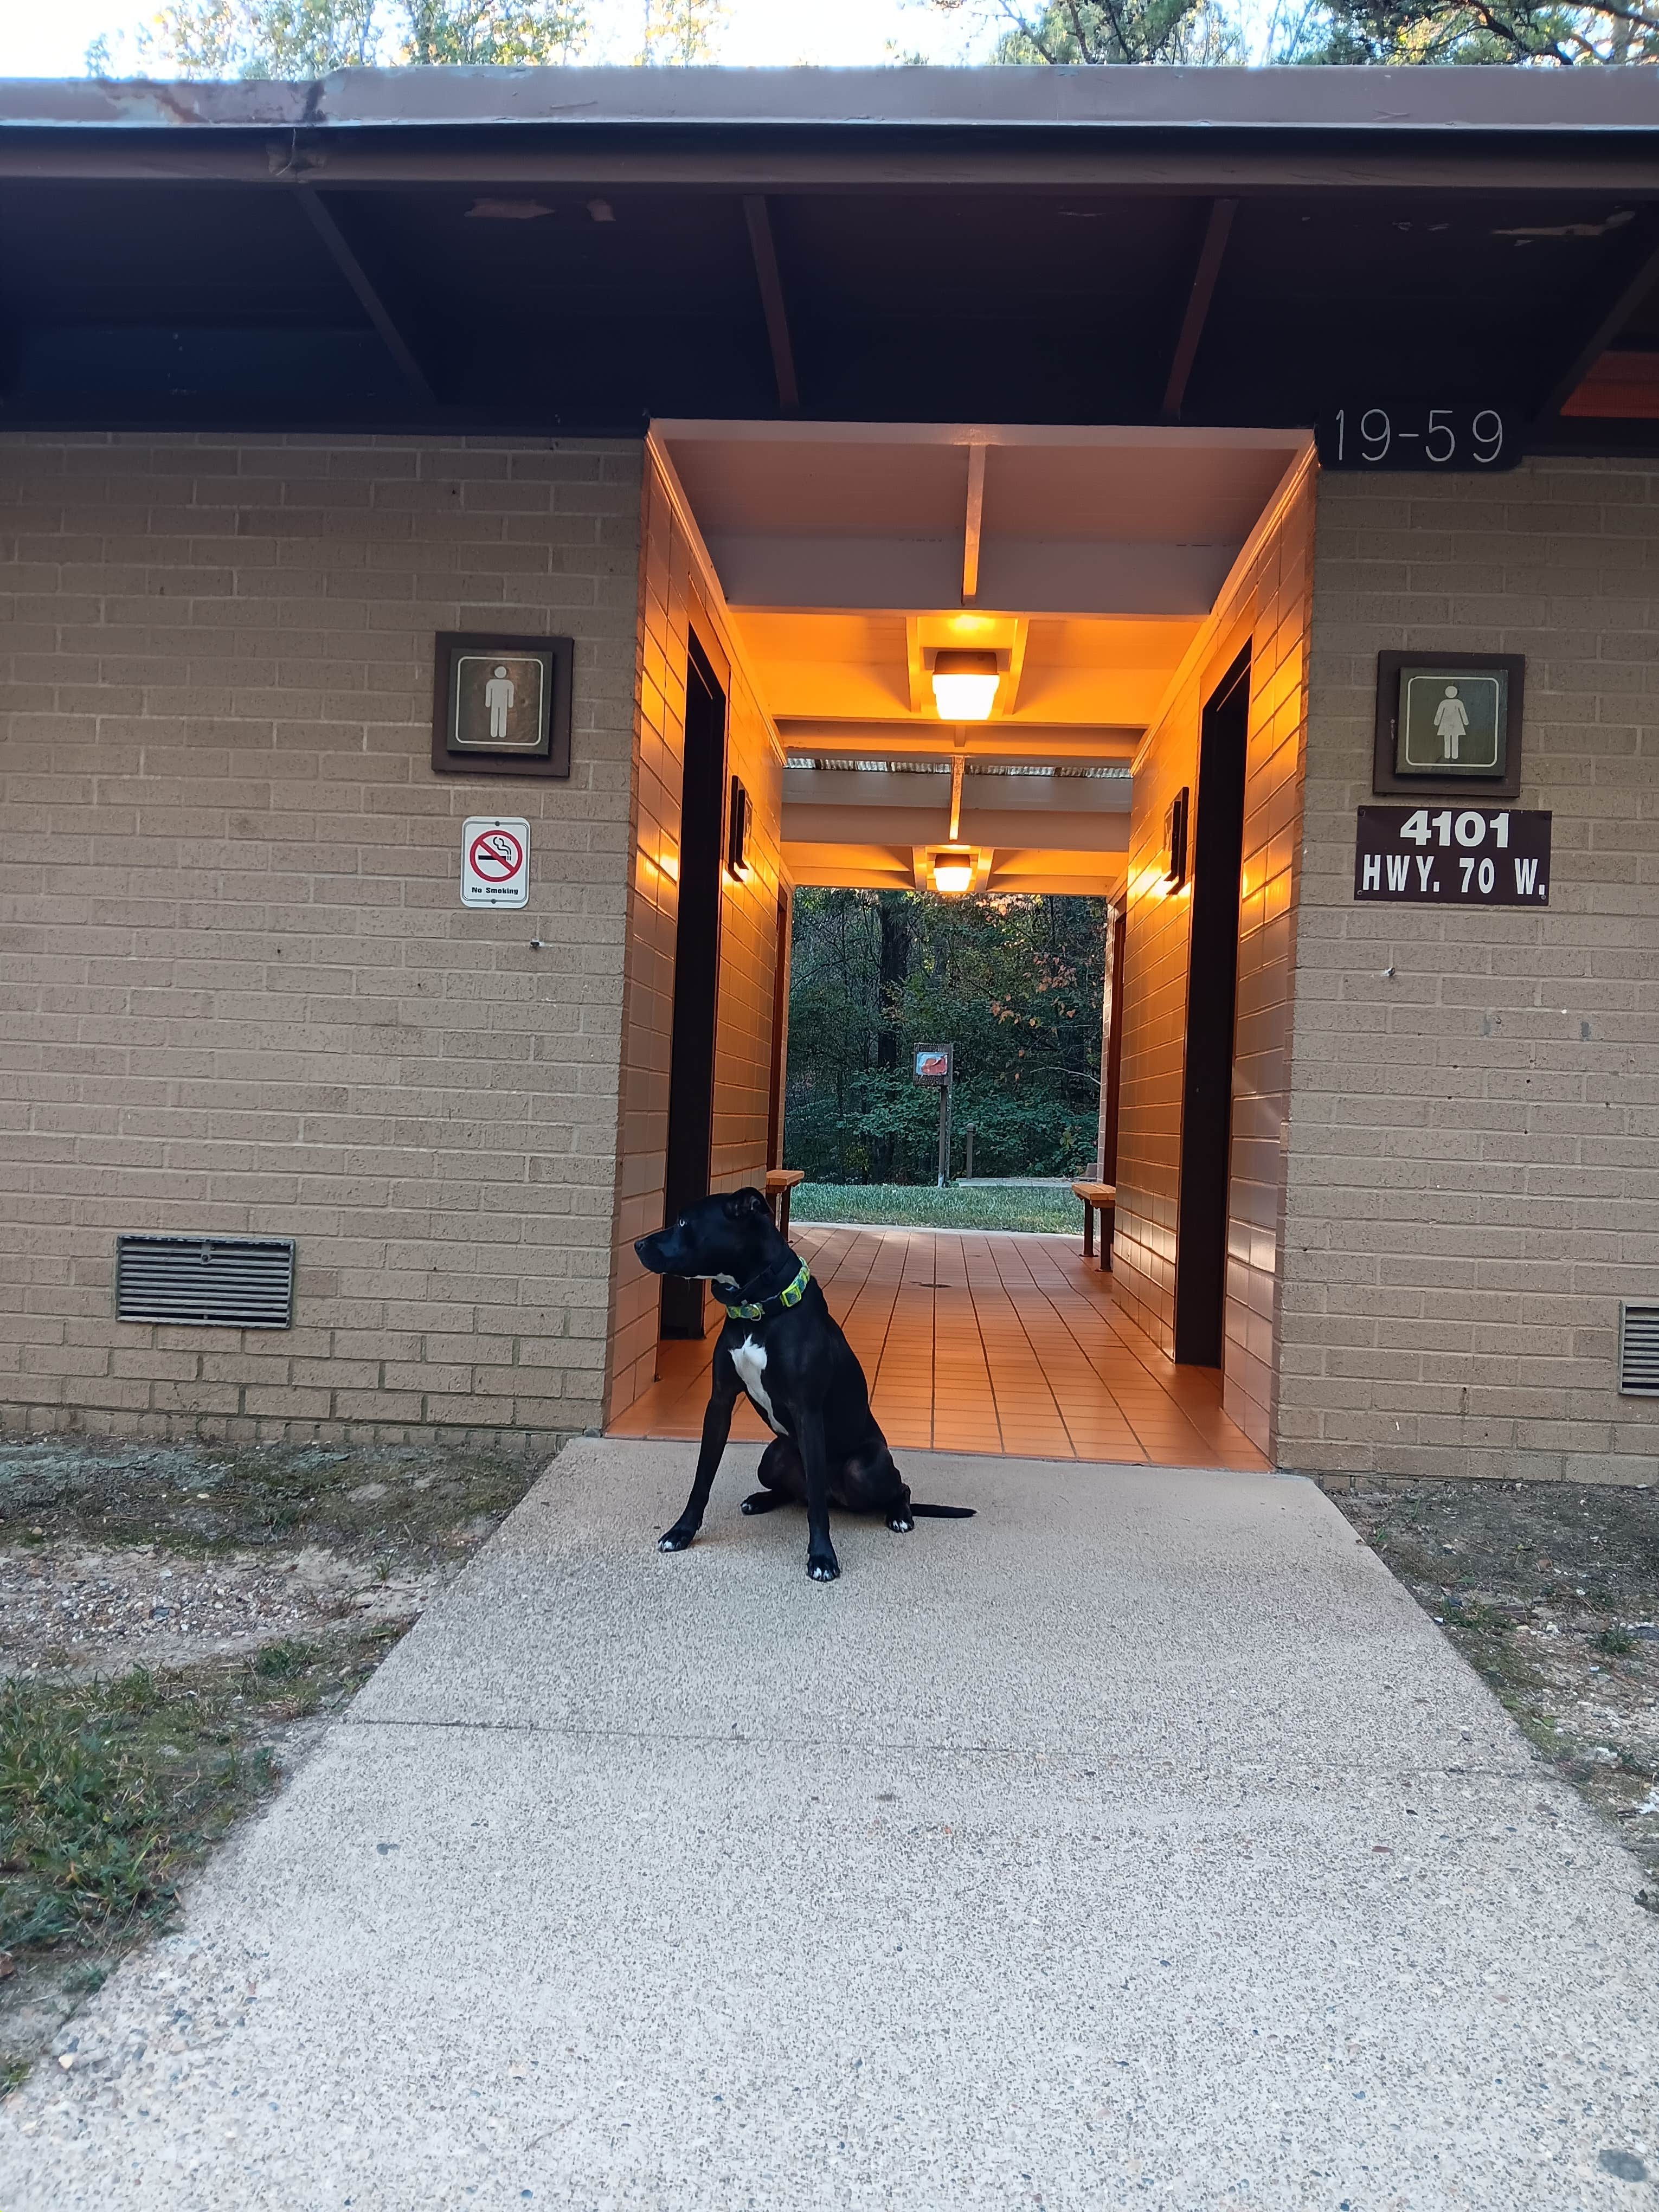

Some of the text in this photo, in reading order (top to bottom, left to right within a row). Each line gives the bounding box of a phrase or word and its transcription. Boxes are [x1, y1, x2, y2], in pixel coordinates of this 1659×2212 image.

[1335, 409, 1503, 463] 19-59
[1400, 810, 1509, 848] 4101
[485, 887, 519, 895] Smoking
[1362, 854, 1545, 895] HWY. 70 W.
